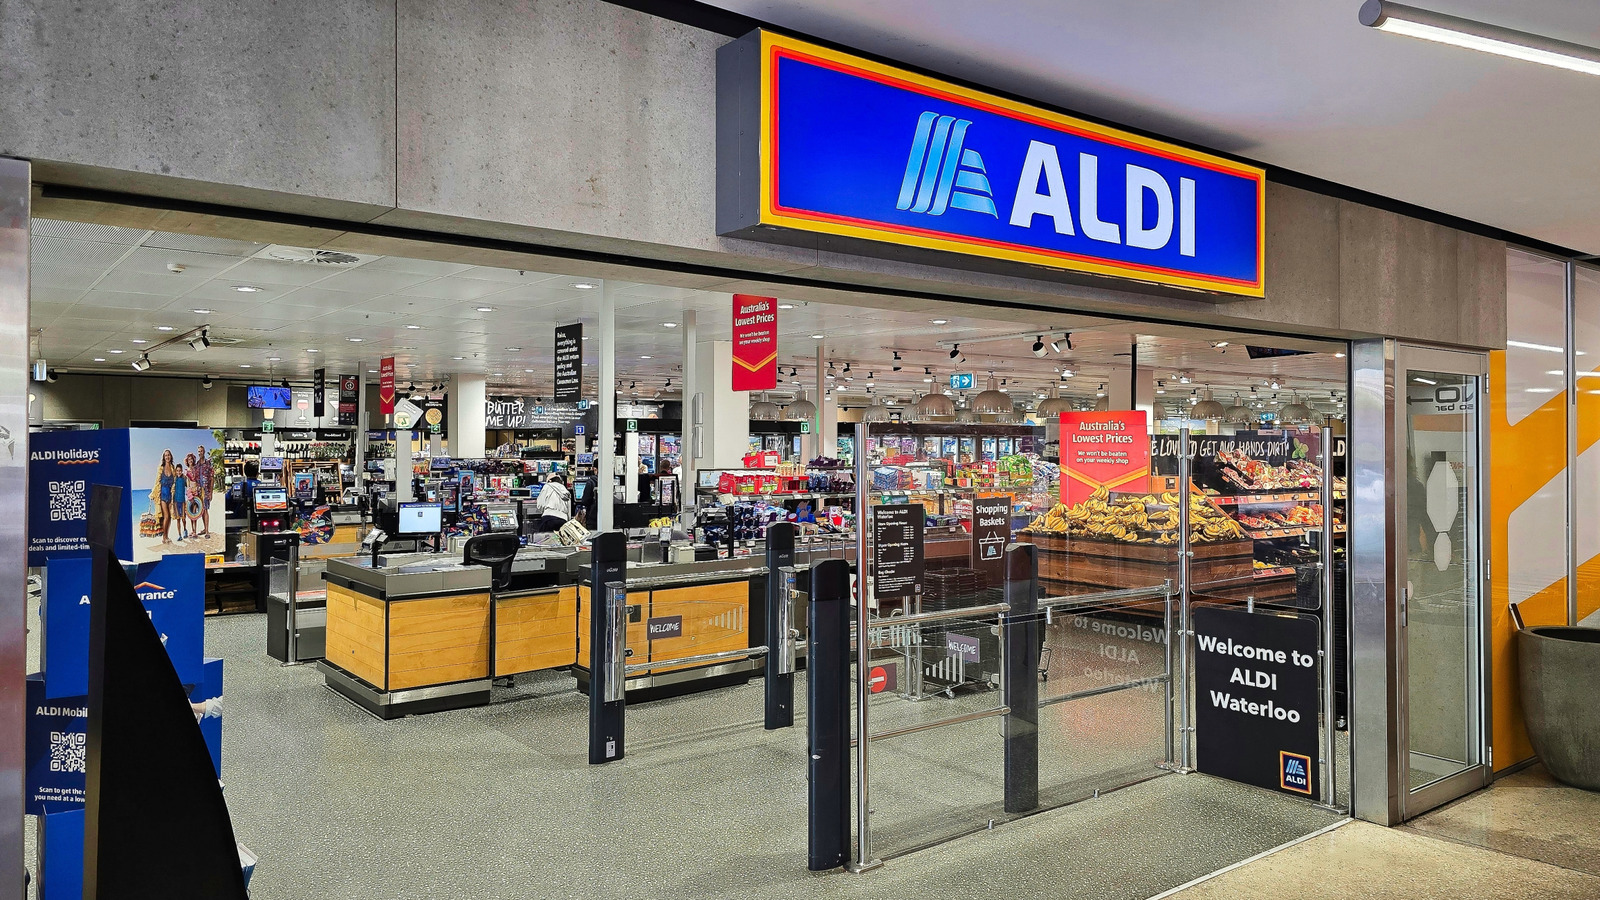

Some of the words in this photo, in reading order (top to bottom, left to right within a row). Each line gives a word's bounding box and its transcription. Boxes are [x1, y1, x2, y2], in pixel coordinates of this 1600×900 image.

[1009, 139, 1196, 257] ALDI
[740, 301, 769, 314] Australia's
[735, 316, 755, 326] Lowest
[756, 313, 774, 323] Prices
[487, 400, 524, 415] BUTTER
[486, 415, 504, 426] ME
[508, 415, 526, 428] UP!
[1079, 420, 1125, 431] Australia's
[1072, 434, 1103, 443] Lowest
[1106, 433, 1133, 443] Prices
[31, 452, 55, 460] ALDI
[57, 448, 99, 461] Holidays
[1160, 439, 1178, 456] LOV
[1200, 440, 1217, 456] GET
[1238, 441, 1265, 457] HANDS
[1267, 441, 1289, 456] DIRTY
[976, 504, 1008, 515] Shopping
[980, 517, 1005, 527] Baskets
[649, 622, 680, 633] WELCOME
[948, 640, 976, 654] WELCOME
[1197, 634, 1287, 664] Welcome
[1292, 650, 1314, 668] to
[1229, 667, 1277, 690] ALDI
[36, 706, 60, 716] ALDI
[62, 707, 88, 717] Mobil
[1209, 689, 1301, 723] Waterloo
[1286, 774, 1306, 786] ALDI
